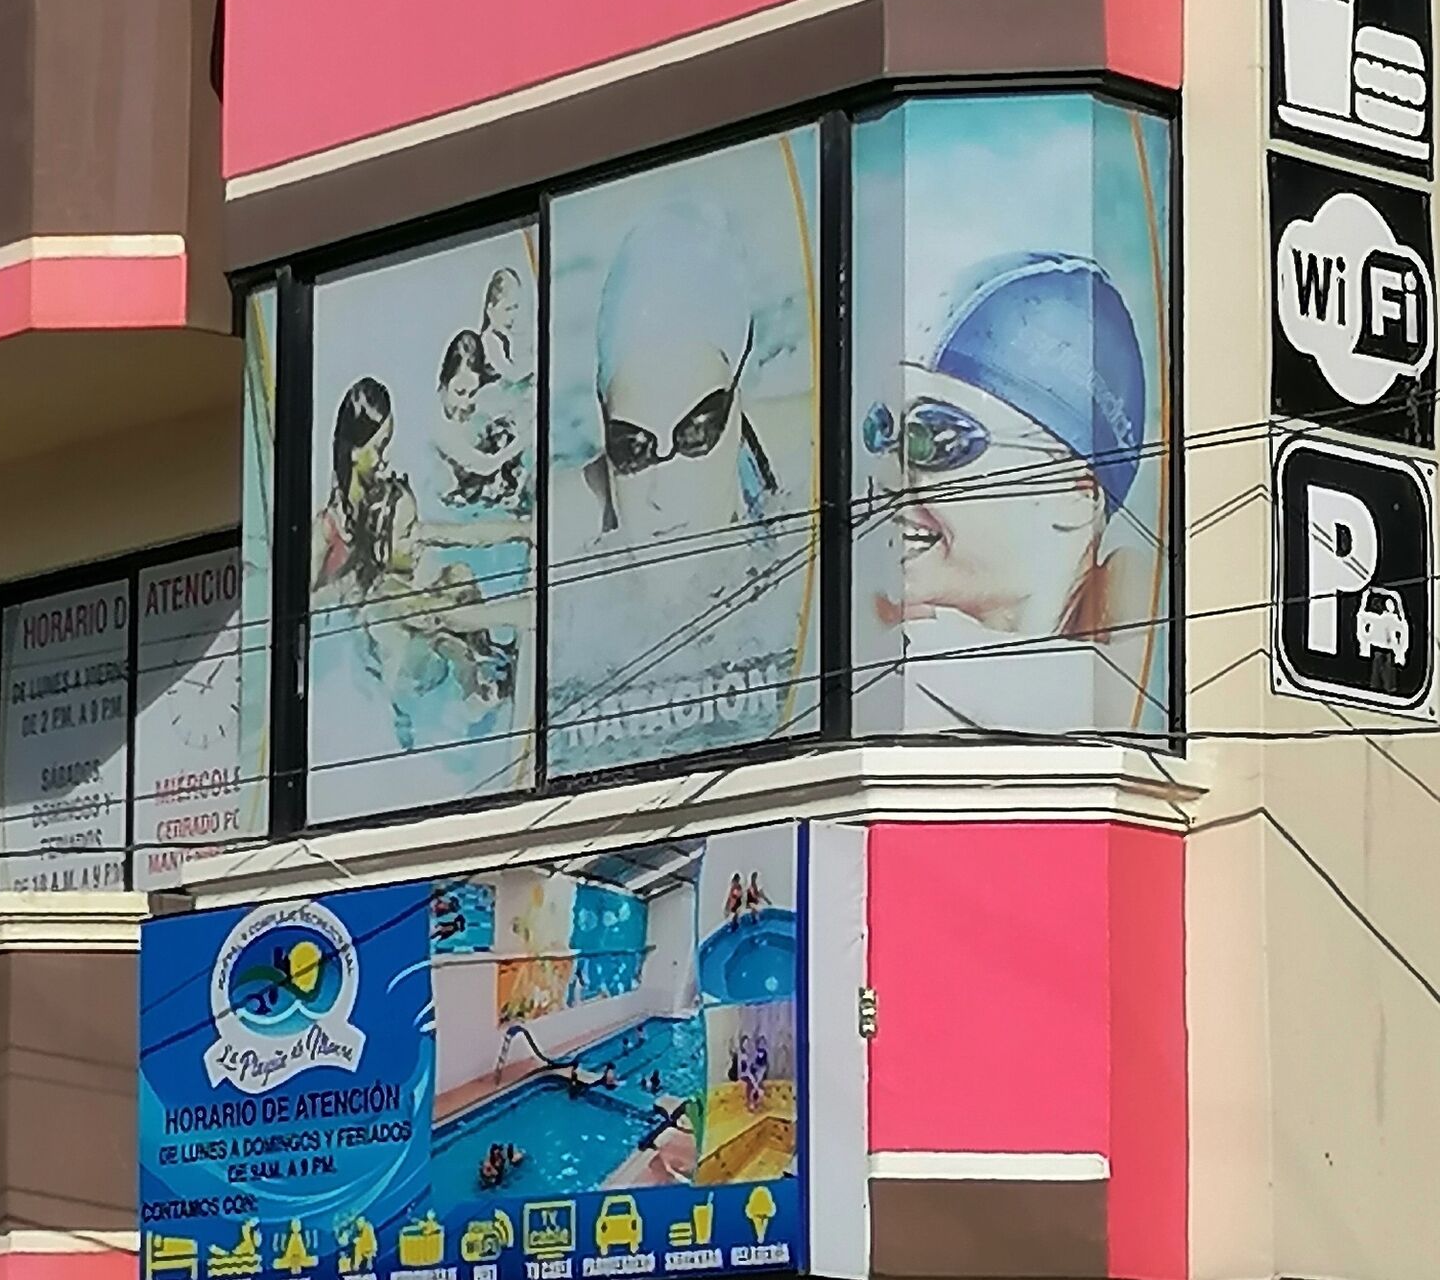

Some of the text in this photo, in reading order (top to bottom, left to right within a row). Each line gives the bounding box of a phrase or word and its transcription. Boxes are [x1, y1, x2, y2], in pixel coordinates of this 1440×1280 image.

[23, 557, 242, 650] HORARIO D ATENCIÓ
[165, 1080, 401, 1135] HORARIO DE ATENCIÓN
[160, 1119, 412, 1166] DE LUNES A DOMINGOS Y FERIADOS
[228, 1162, 248, 1183] DE
[287, 1160, 298, 1178] A
[142, 1197, 220, 1223] CONTAMOS
